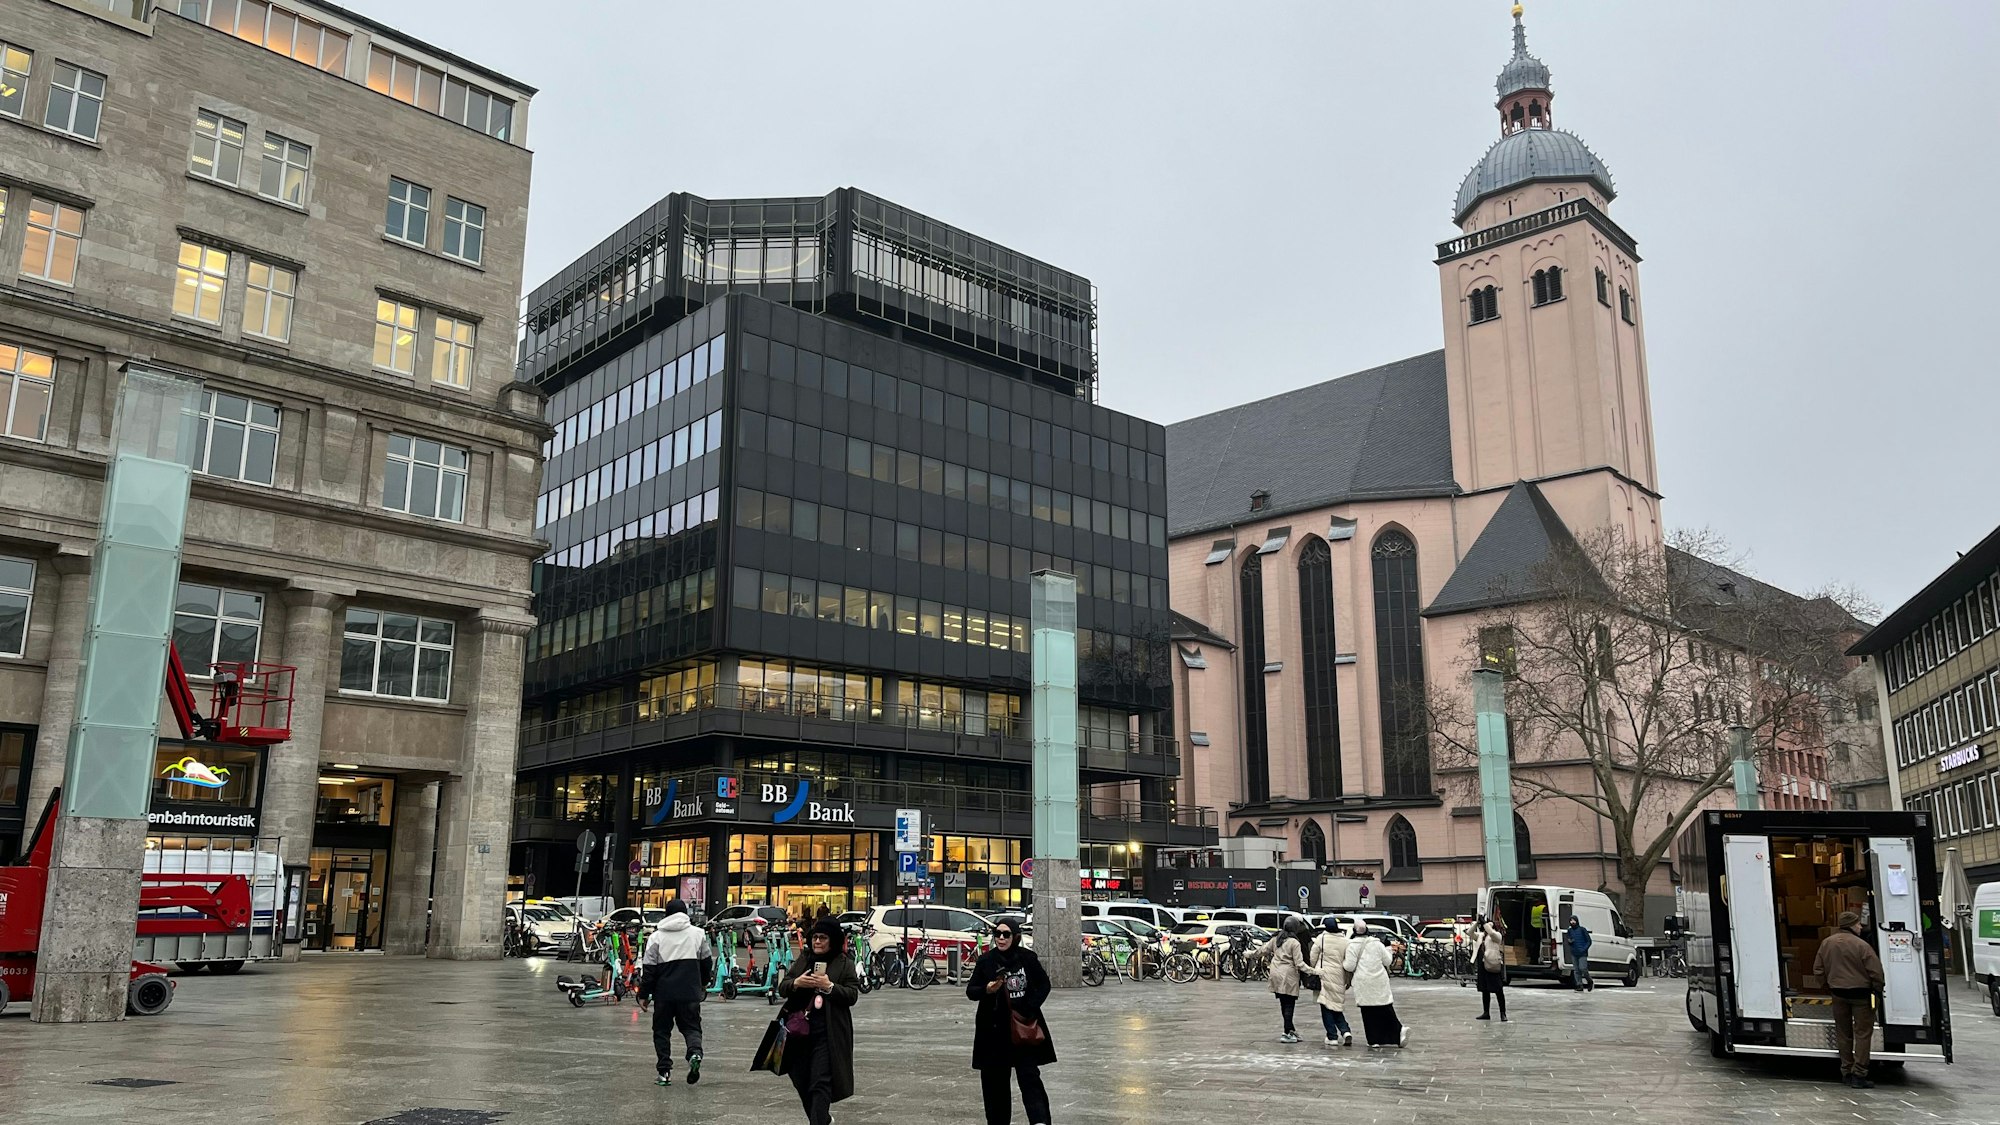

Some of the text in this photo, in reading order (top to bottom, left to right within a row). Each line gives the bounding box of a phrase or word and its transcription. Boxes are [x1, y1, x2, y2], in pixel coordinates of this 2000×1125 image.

[1940, 744, 1980, 772] STARBUCKS
[645, 787, 703, 818] BB Bank
[761, 783, 855, 822] BB Bank
[903, 854, 913, 871] P
[1094, 880, 1106, 889] AM
[1188, 881, 1215, 890] BISTRO
